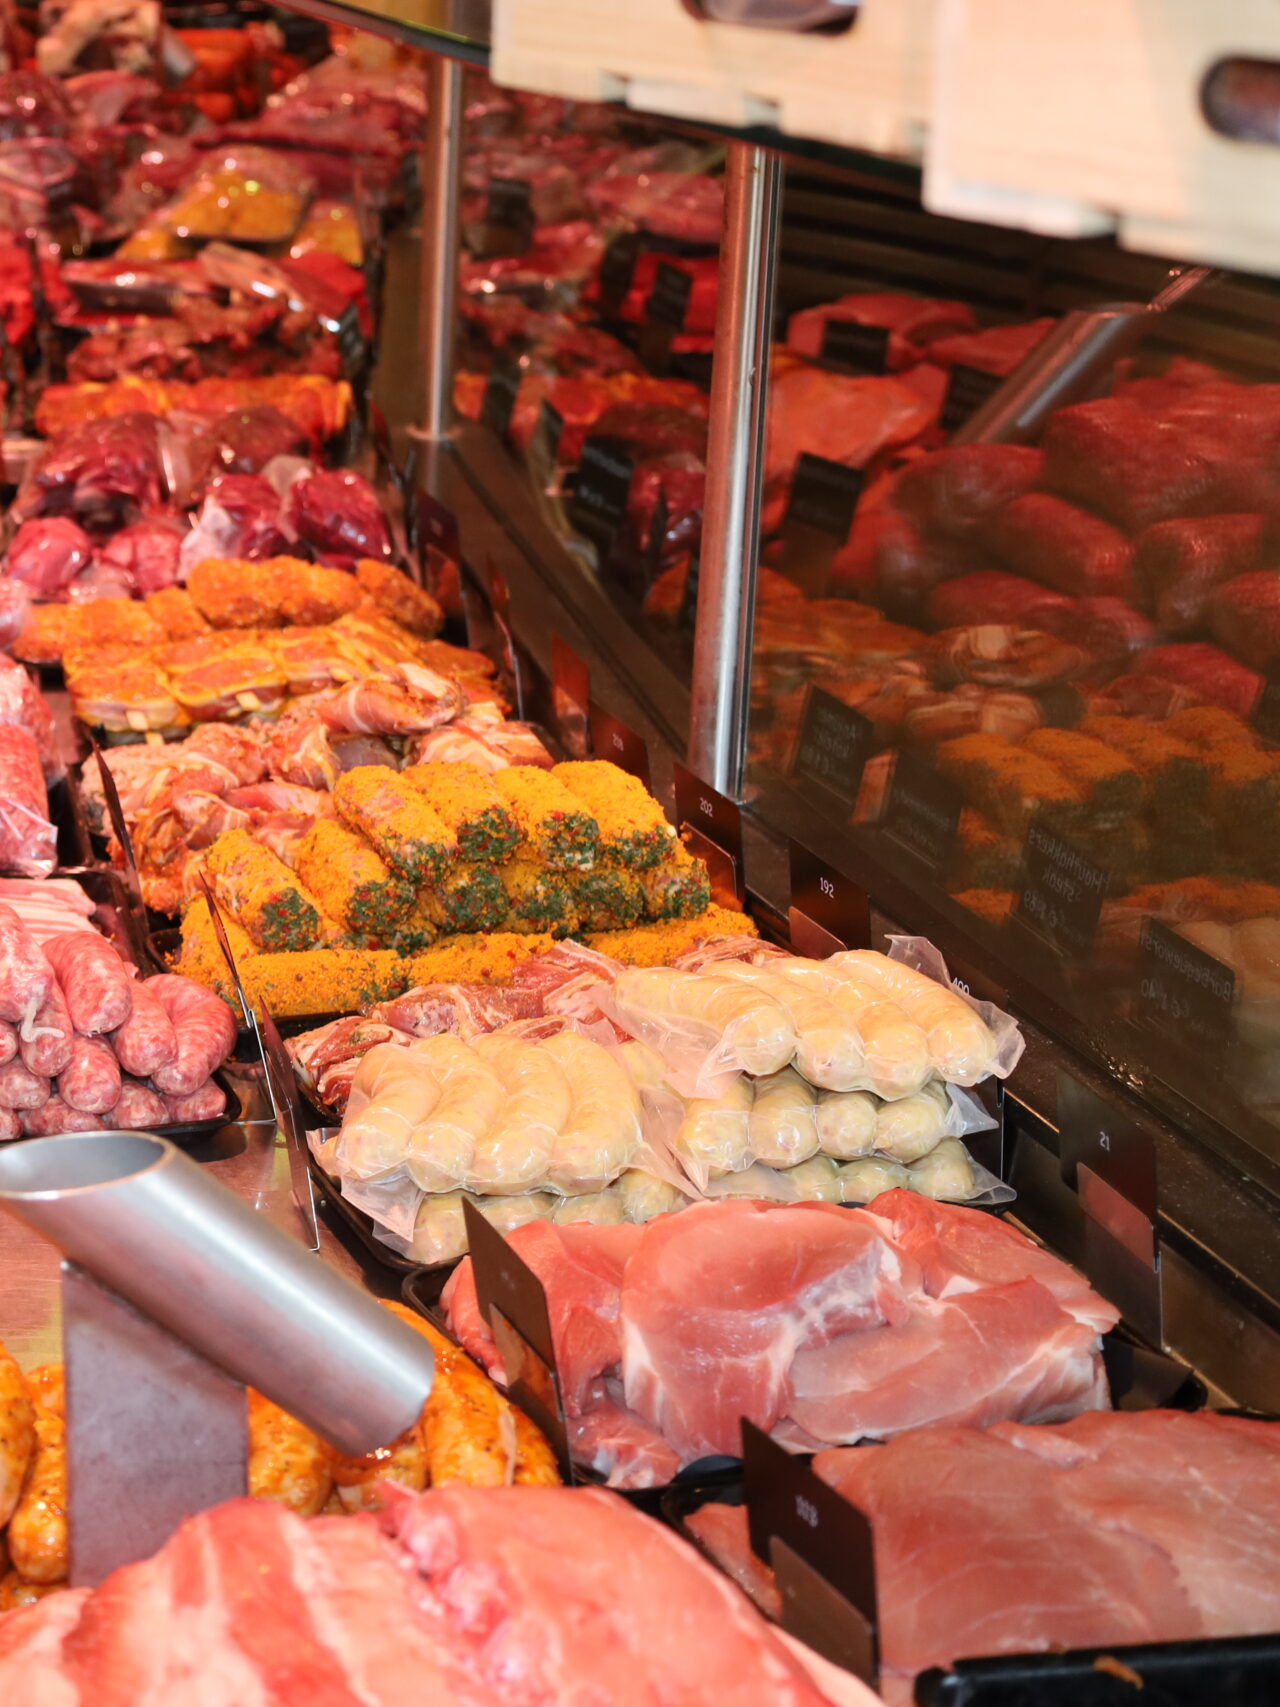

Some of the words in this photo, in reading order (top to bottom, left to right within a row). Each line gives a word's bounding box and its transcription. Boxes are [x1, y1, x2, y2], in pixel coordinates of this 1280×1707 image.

[699, 796, 713, 817] 202
[820, 876, 834, 899] 192
[1099, 1131, 1110, 1152] 21
